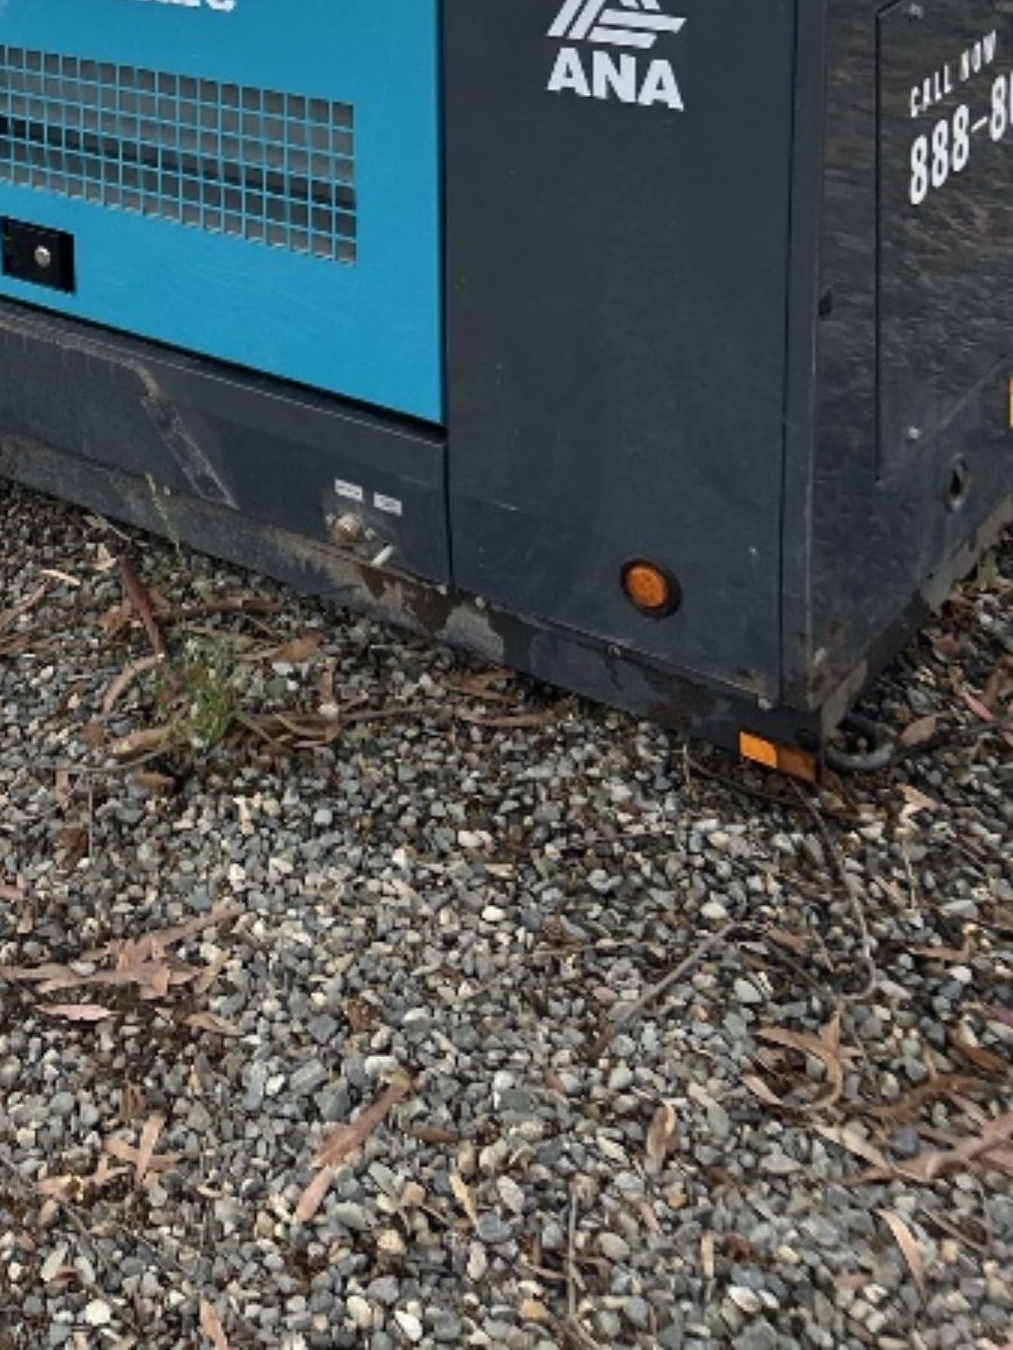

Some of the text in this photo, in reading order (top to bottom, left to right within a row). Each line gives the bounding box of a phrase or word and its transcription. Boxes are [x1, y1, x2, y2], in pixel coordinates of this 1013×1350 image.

[545, 47, 685, 112] ANA
[910, 29, 997, 118] CALL NOW
